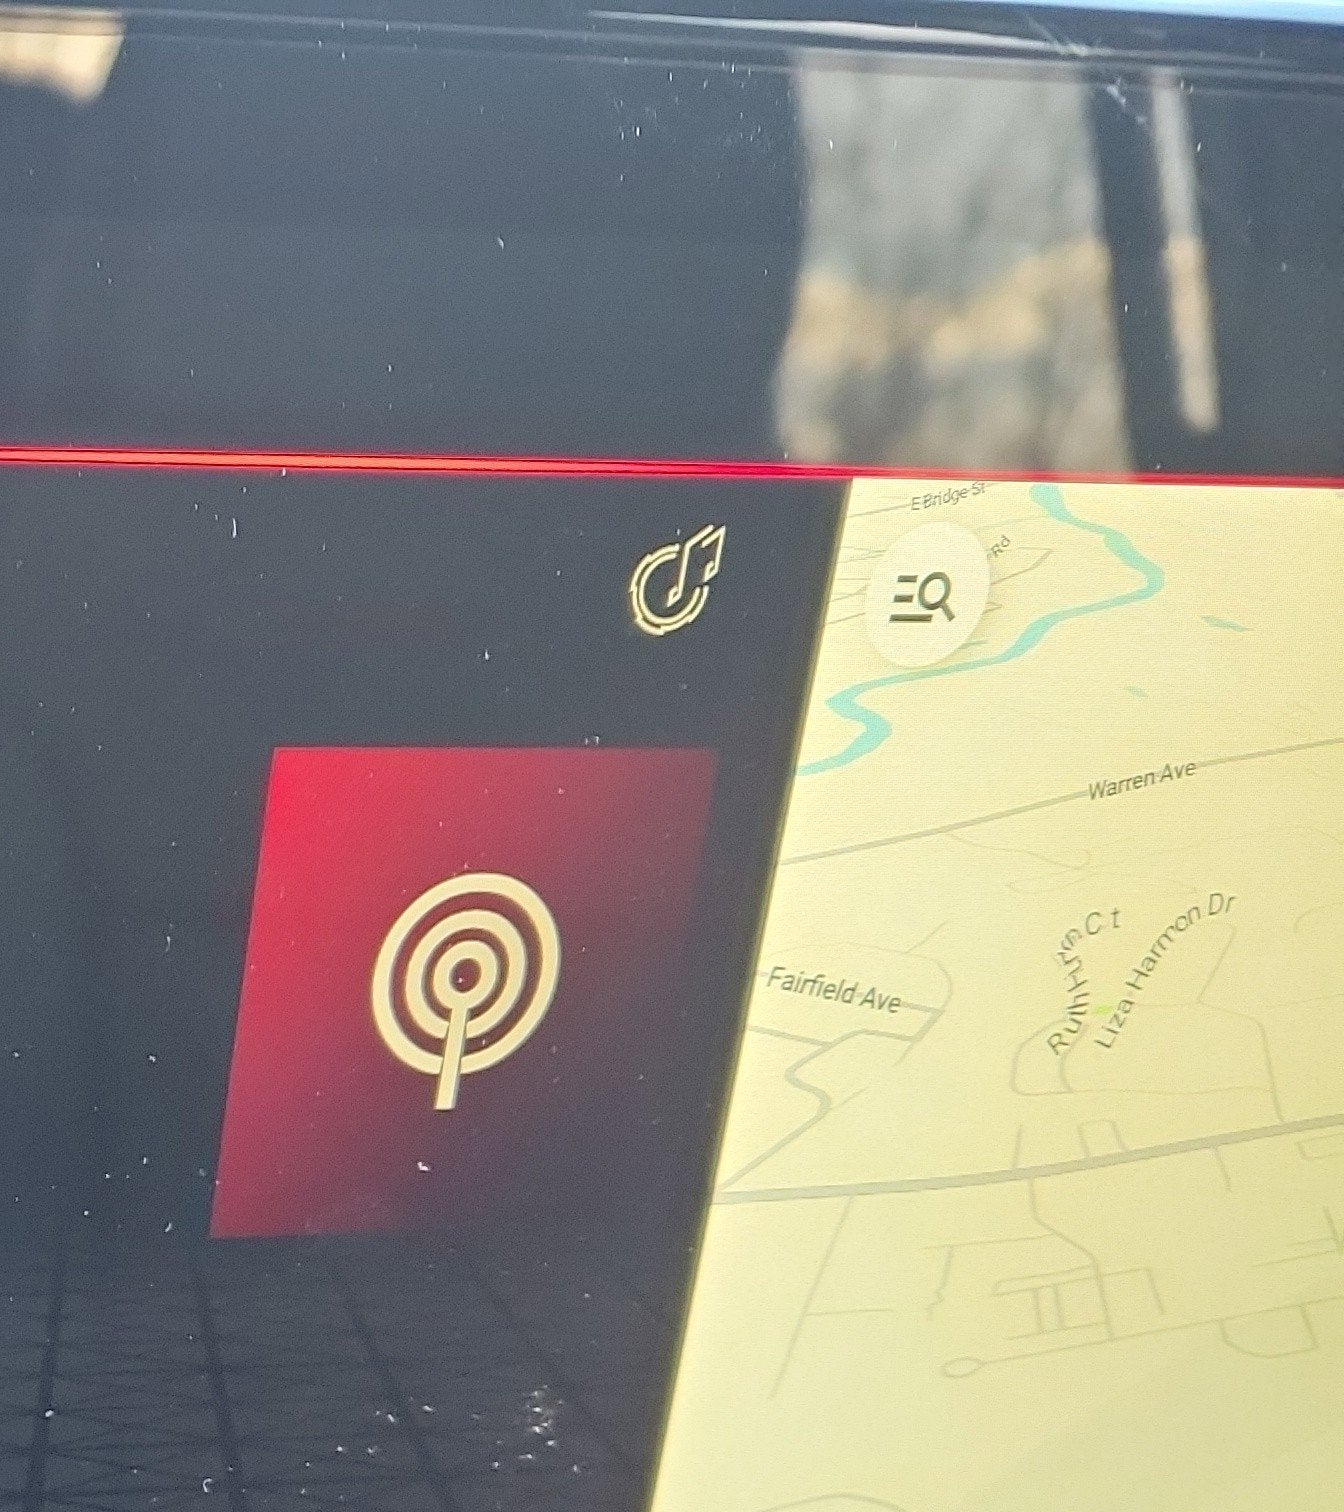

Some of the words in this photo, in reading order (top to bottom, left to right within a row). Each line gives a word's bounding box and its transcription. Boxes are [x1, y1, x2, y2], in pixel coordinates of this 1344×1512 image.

[922, 487, 968, 509] Bridge
[1088, 771, 1156, 801] Warren
[1159, 762, 1198, 783] Ave
[766, 965, 860, 1004] Fairfield
[858, 986, 903, 1015] Ave
[1093, 998, 1136, 1049] Liza
[1124, 905, 1202, 991] Harmon
[1208, 892, 1237, 916] Dr
[1046, 991, 1091, 1056] Ruth
